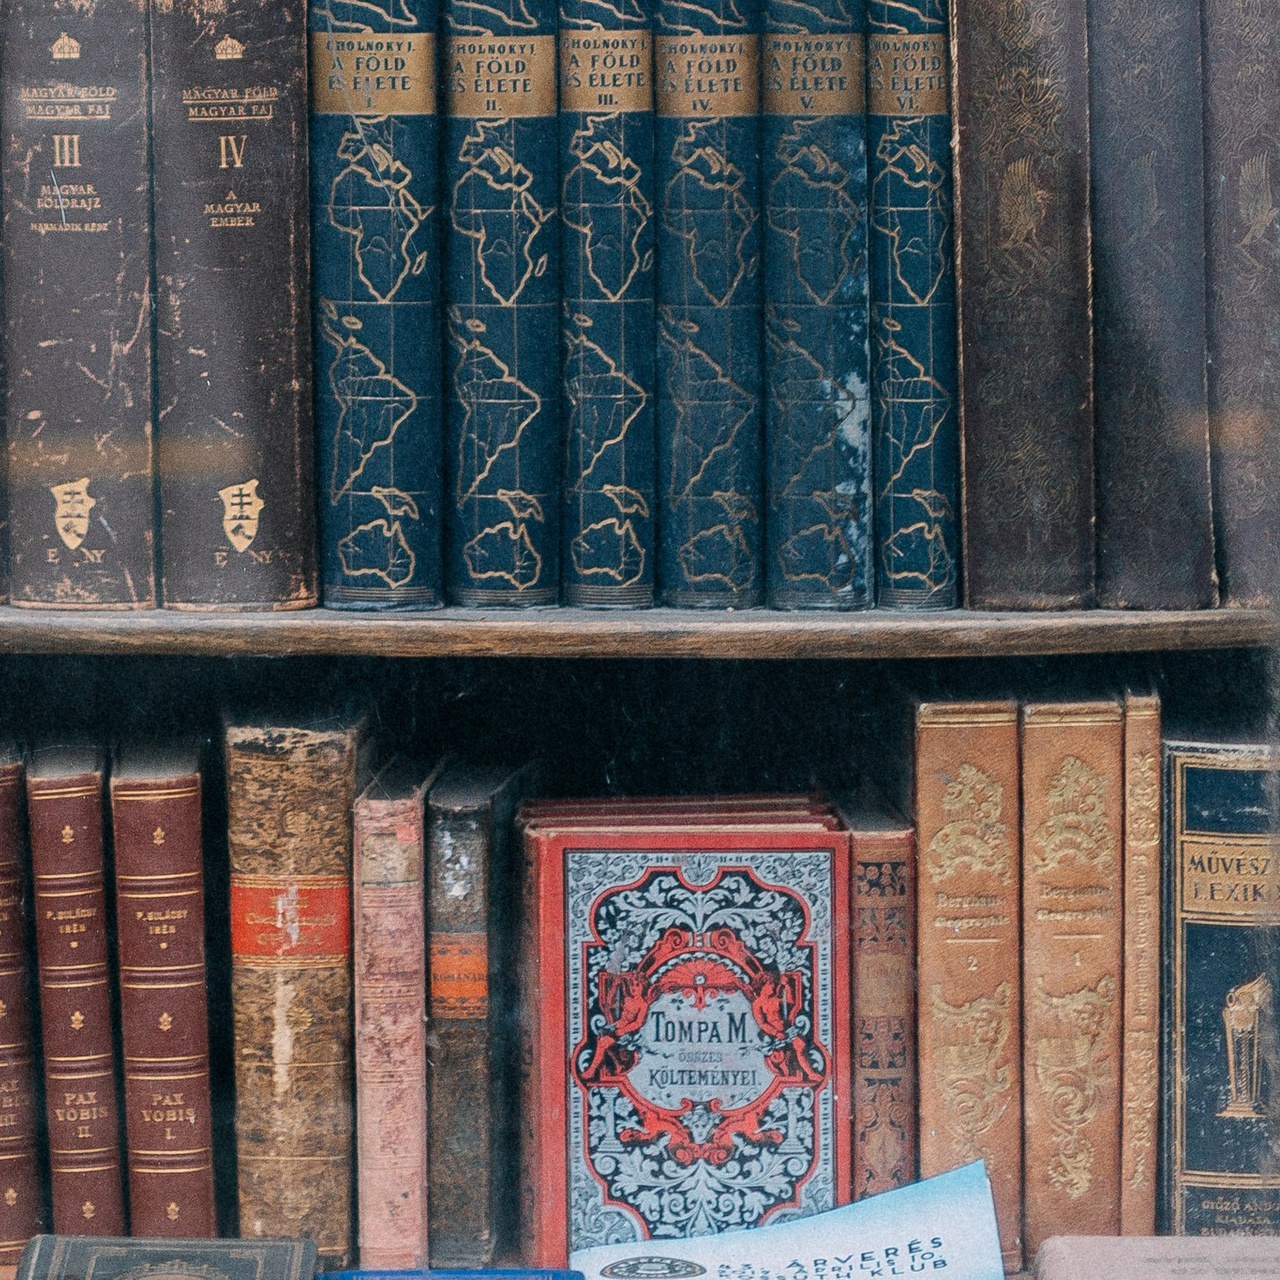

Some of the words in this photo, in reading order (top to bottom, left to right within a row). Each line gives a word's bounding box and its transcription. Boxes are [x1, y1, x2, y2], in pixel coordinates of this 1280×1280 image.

[454, 60, 465, 74] A
[475, 56, 527, 74] FÖLD
[569, 53, 581, 69] A
[591, 51, 641, 69] FÖLD
[667, 59, 678, 75] A
[686, 56, 738, 75] FÖLD
[474, 74, 532, 93] ÉLETE
[588, 69, 646, 88] ÉLETE
[684, 74, 742, 94] ÉLETE
[20, 86, 75, 99] MAGYAR
[182, 87, 239, 100] MAGYAR
[25, 104, 82, 116] MAGYAR
[87, 104, 111, 118] FAJ
[188, 105, 247, 117] MAGYAR
[251, 103, 274, 118] FAJ
[52, 134, 82, 167] III
[219, 134, 248, 168] IV
[40, 184, 97, 195] MAGYAR
[226, 190, 237, 201] A
[204, 202, 261, 214] MAGYAR
[210, 215, 255, 227] EMBER
[81, 547, 107, 564] NY
[250, 550, 273, 564] NY
[1188, 850, 1280, 875] MŰVÉSZ
[1194, 881, 1280, 902] LEXIK
[966, 954, 979, 971] 2
[1073, 950, 1082, 966] 1
[650, 1011, 722, 1044] TOMPA
[727, 1012, 754, 1044] M.
[64, 1091, 98, 1106] PAX
[151, 1093, 185, 1107] PAX
[55, 1107, 109, 1122] VOBIS
[141, 1107, 196, 1123] VOBIS
[786, 1237, 943, 1269] ÁRVERÉS
[870, 1259, 948, 1277] KLUB
